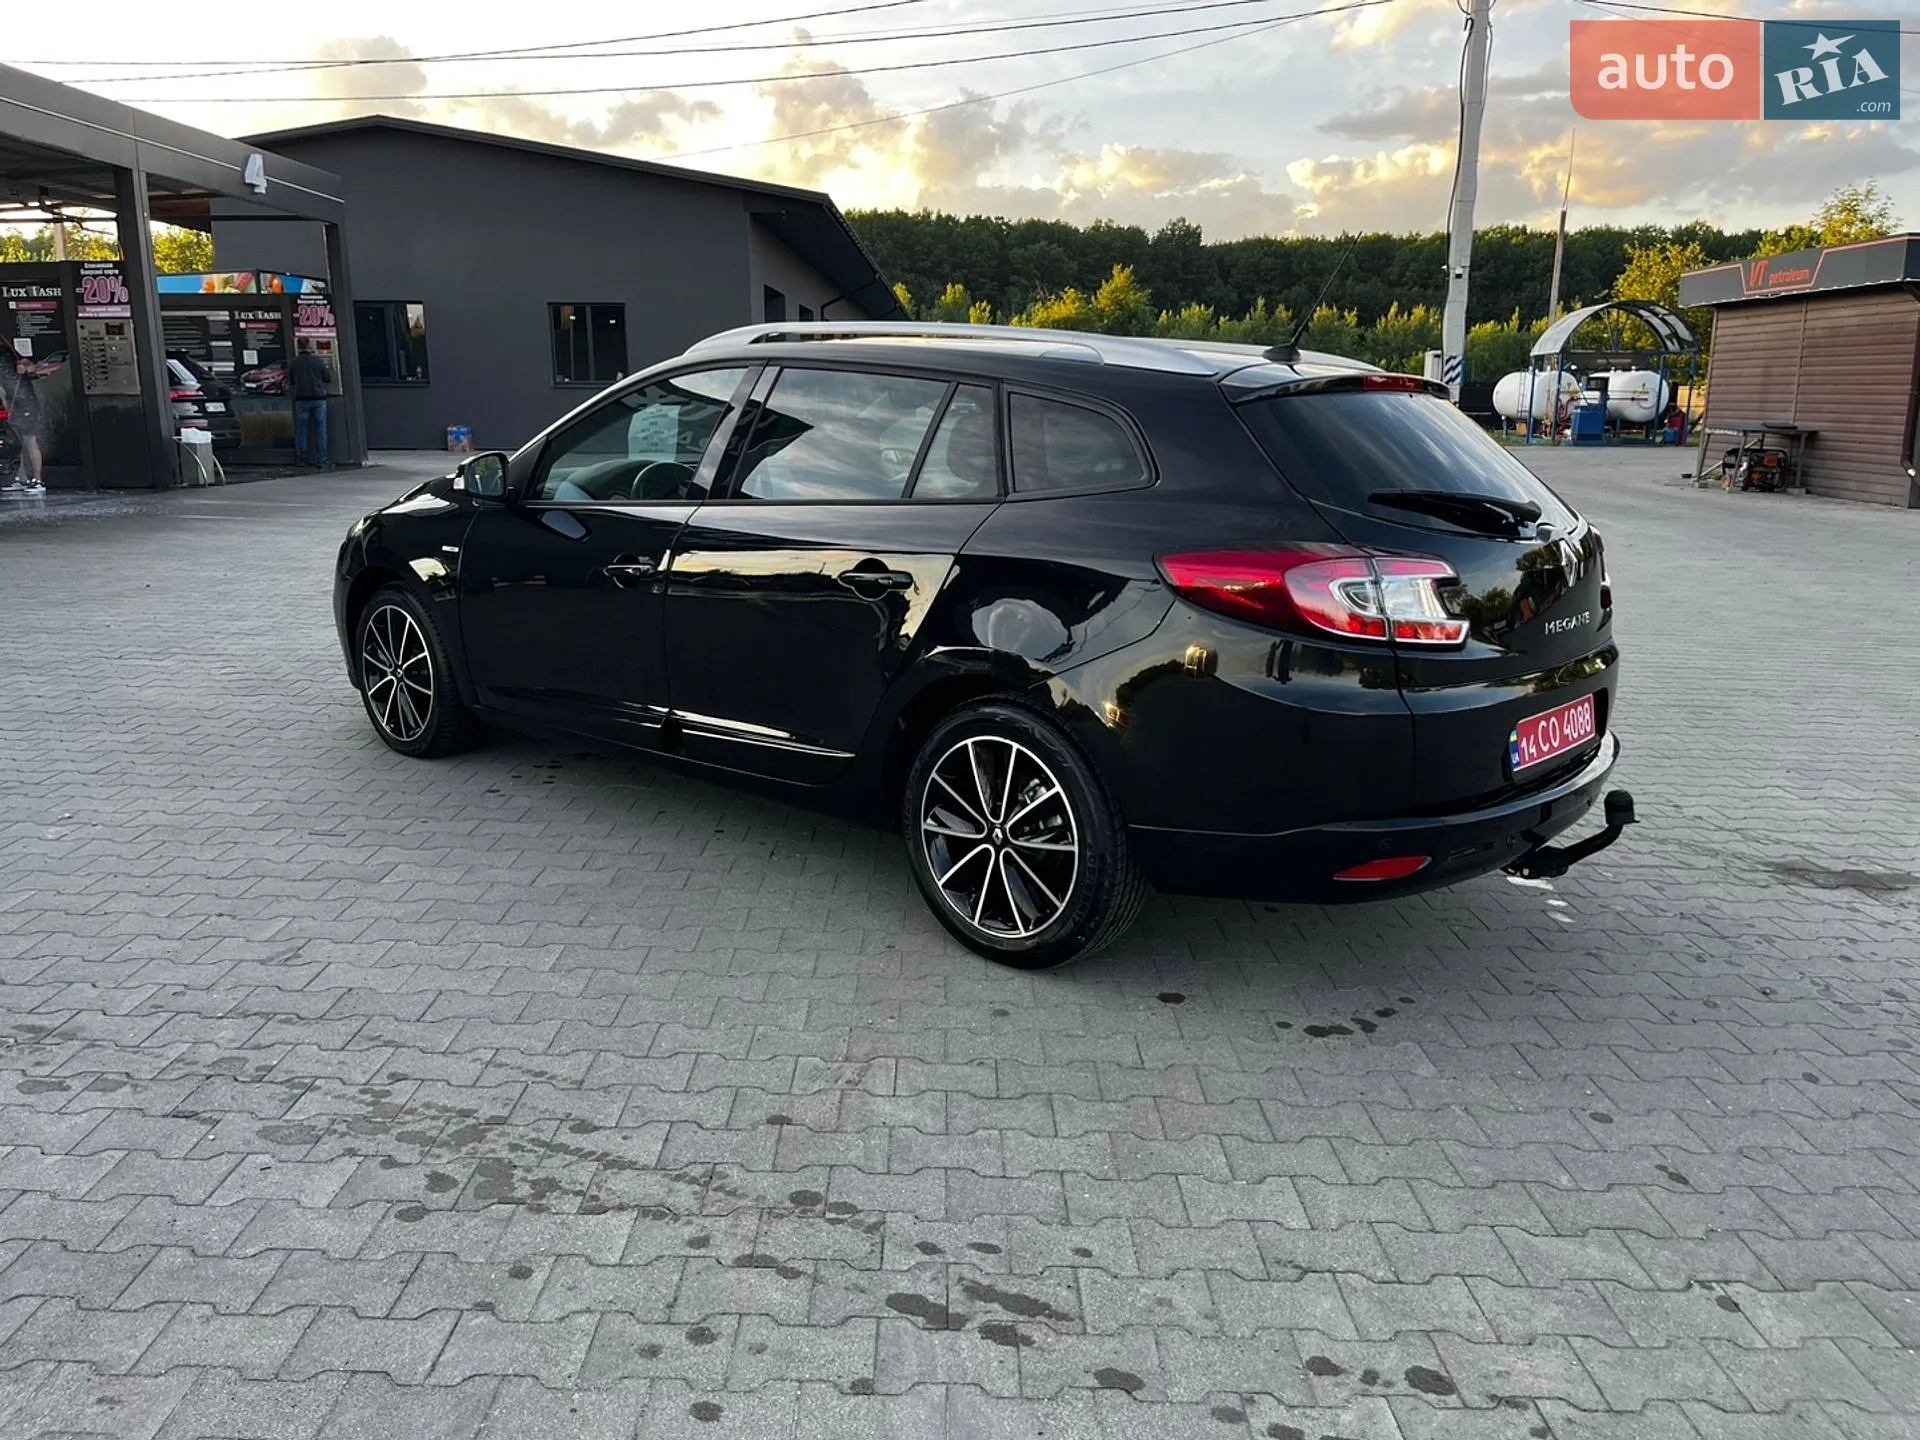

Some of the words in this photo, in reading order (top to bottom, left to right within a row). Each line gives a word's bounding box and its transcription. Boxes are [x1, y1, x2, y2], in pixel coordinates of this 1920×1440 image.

[245, 153, 267, 194] 4
[76, 276, 129, 304] -20%
[1769, 269, 1809, 286] petroleum
[292, 305, 335, 326] -20%
[1545, 611, 1590, 635] MEGANE
[1520, 733, 1538, 762] 14
[1538, 719, 1560, 753] CO
[1563, 702, 1592, 741] 4088
